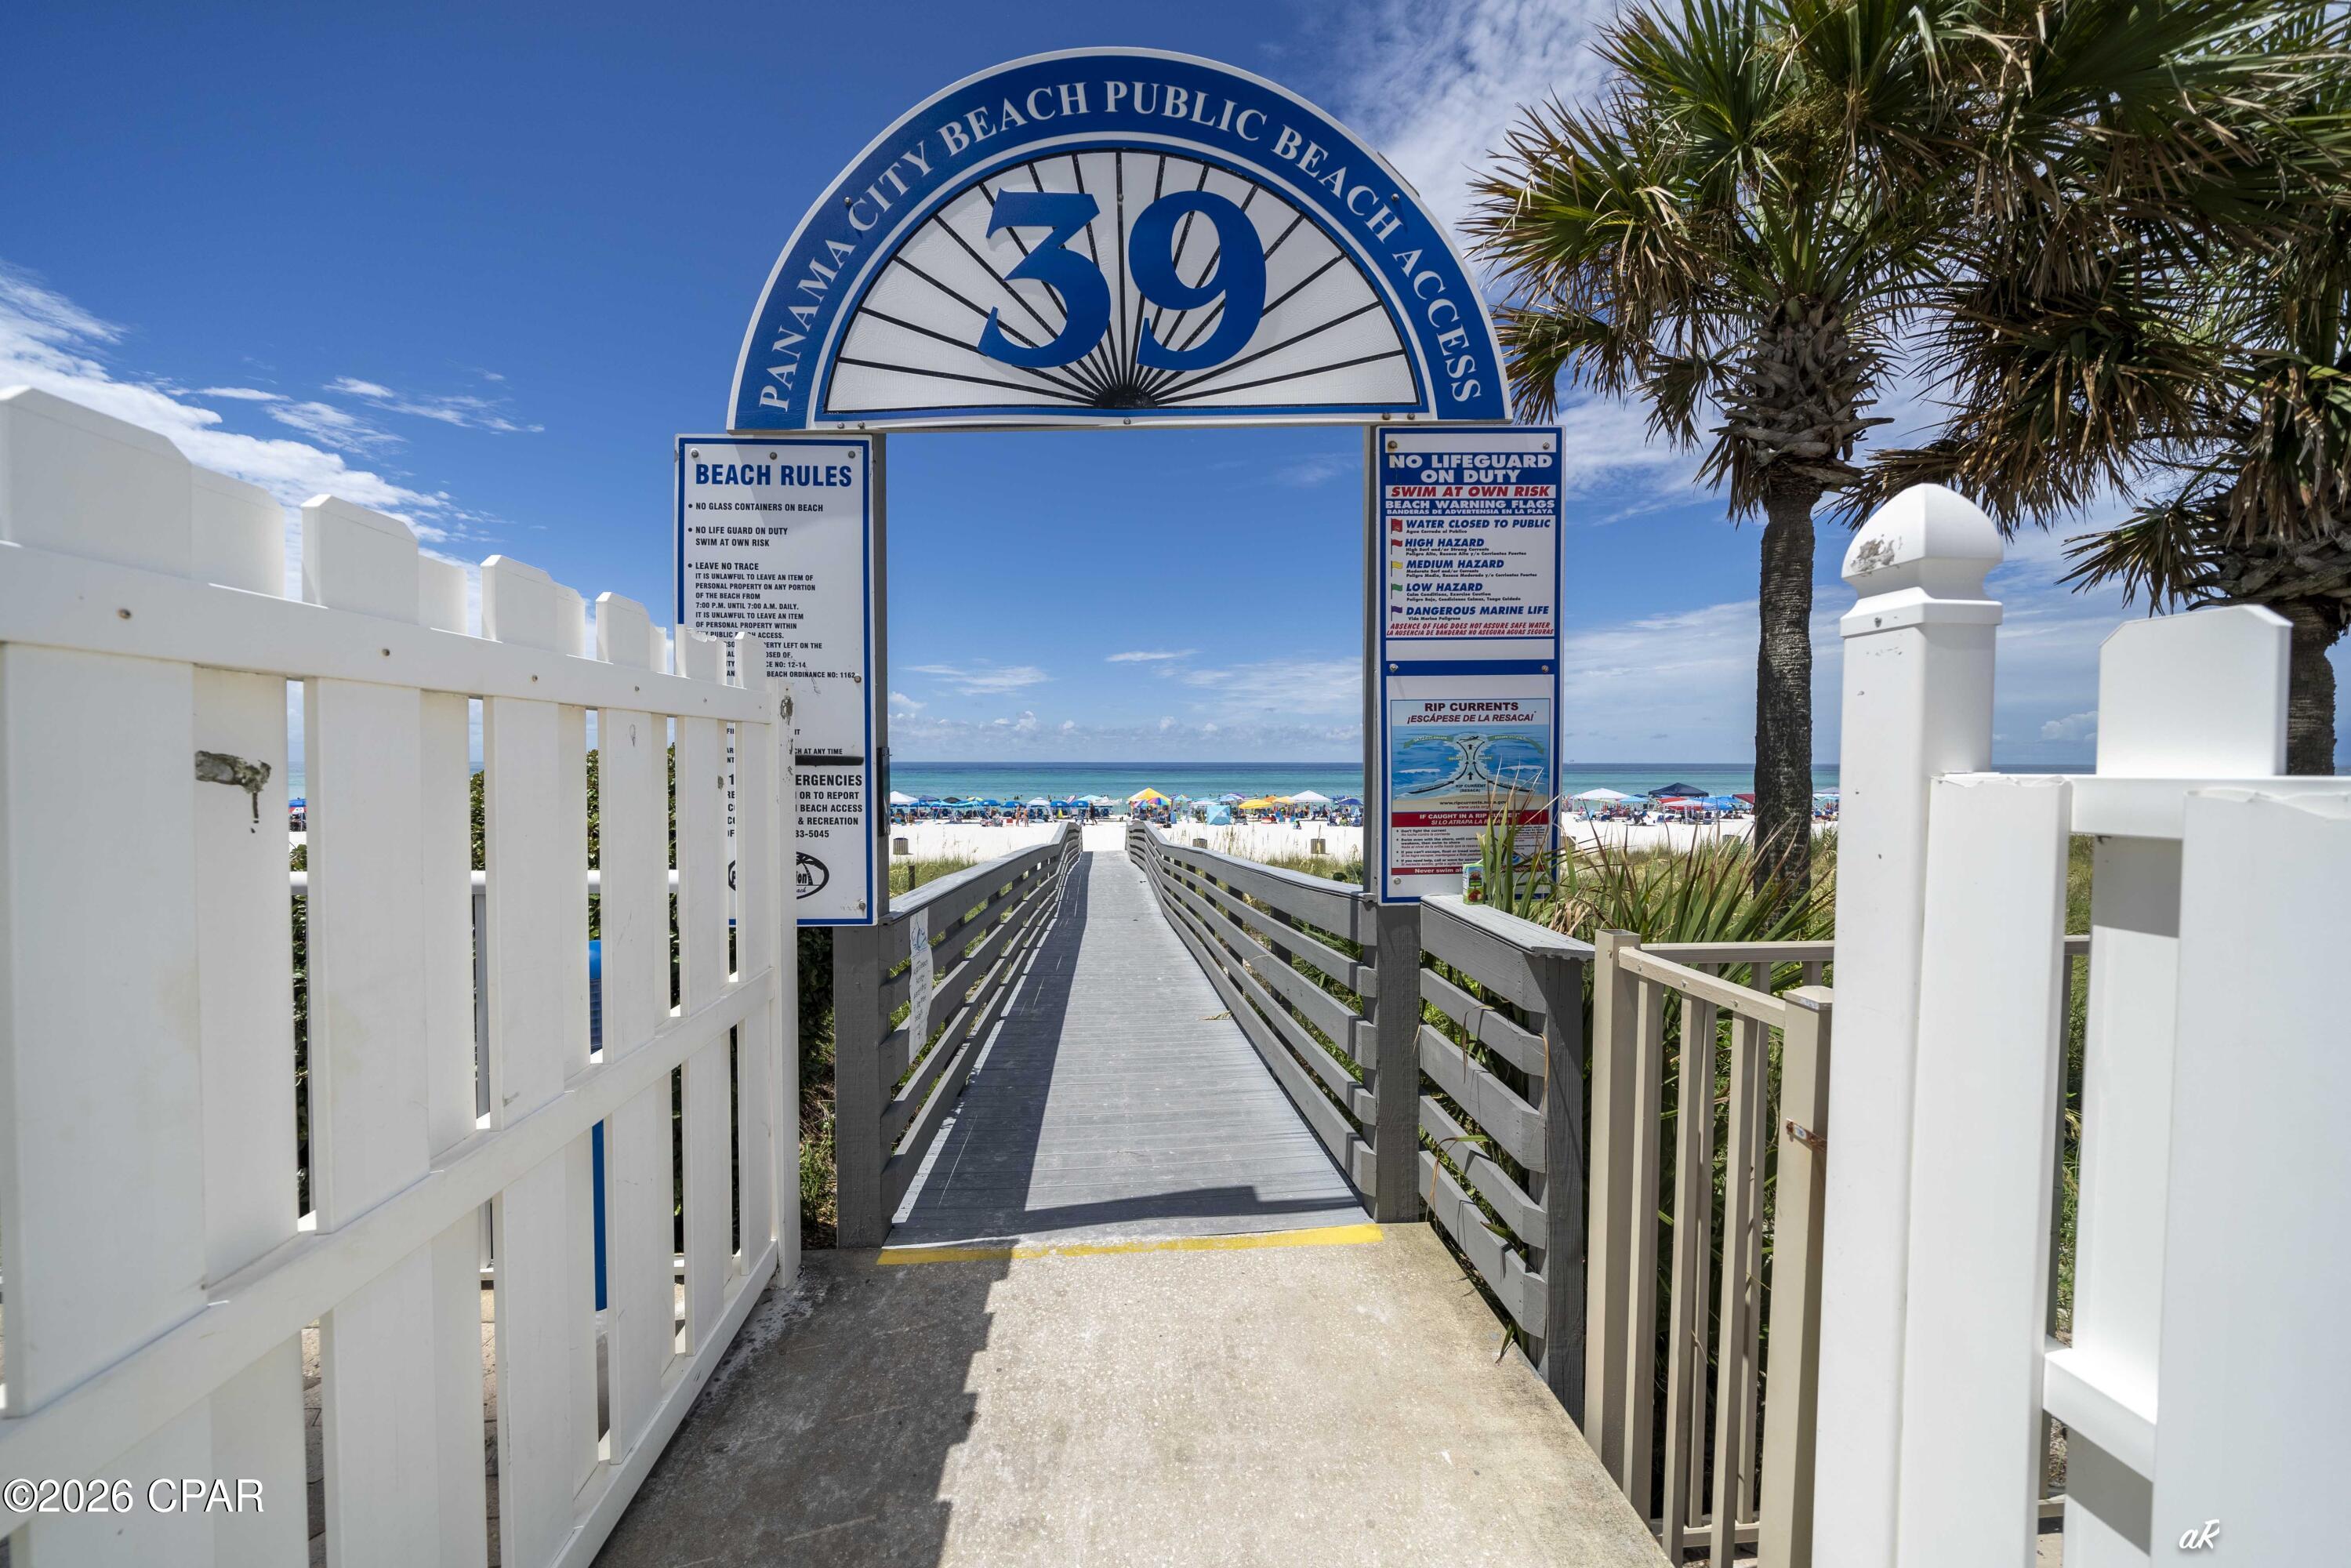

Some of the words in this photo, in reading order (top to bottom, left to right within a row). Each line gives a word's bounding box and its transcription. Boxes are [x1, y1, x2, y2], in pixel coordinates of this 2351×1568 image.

[759, 238, 853, 411] PANAMA
[849, 140, 936, 232] CITY
[938, 82, 1088, 158] BEACH
[1103, 80, 1268, 142] PUBLIC
[1270, 125, 1405, 245] BEACH
[1393, 250, 1482, 403] ACCESS
[977, 188, 1267, 372] 39
[1389, 455, 1423, 468] NO
[1431, 454, 1552, 468] LIFEGUARD
[695, 463, 771, 485] BEACH
[781, 465, 851, 487] RULES
[1420, 470, 1454, 483] ON
[1464, 469, 1521, 483] DUTY
[1391, 485, 1436, 497] SWIM
[1442, 486, 1464, 497] AT
[1468, 486, 1508, 497] OWN
[1514, 485, 1551, 496] RISK
[709, 502, 732, 510] GLASS
[735, 503, 782, 511] CONTAINERS
[797, 503, 823, 512] BEACH
[1385, 500, 1430, 510] BEACH
[1435, 499, 1506, 509] WARNING
[1511, 499, 1555, 509] FLAGS
[1406, 519, 1445, 528] WATER
[1448, 519, 1489, 528] CLOSED
[1493, 519, 1508, 528] TO
[1511, 519, 1551, 528] PUBLIC
[695, 526, 706, 535] NO
[709, 526, 724, 535] LIFE
[727, 526, 753, 535] GUARD
[755, 527, 765, 535] ON
[768, 527, 788, 535] DUTY
[695, 538, 717, 546] SWIM
[720, 538, 729, 546] AT
[731, 538, 749, 546] OWN
[752, 539, 769, 547] RISK
[1404, 539, 1434, 547] HIGH
[695, 561, 719, 570] LEAVE
[721, 562, 731, 571] NO
[734, 562, 759, 571] TRACE
[1406, 559, 1453, 568] MEDIUM
[1457, 559, 1504, 568] HAZARD
[1406, 583, 1433, 591] LOW
[1435, 583, 1483, 591] HAZARD
[1406, 606, 1476, 615] DANGEROUS
[1478, 605, 1524, 615] MARINE
[1527, 605, 1549, 615] LIFE
[1424, 702, 1446, 711] RIP
[1449, 702, 1518, 711] CURRENTS
[795, 774, 862, 786] ERGENCIES
[827, 791, 859, 800] REPORT
[800, 804, 827, 812] BEACH
[830, 804, 862, 812] ACCESS
